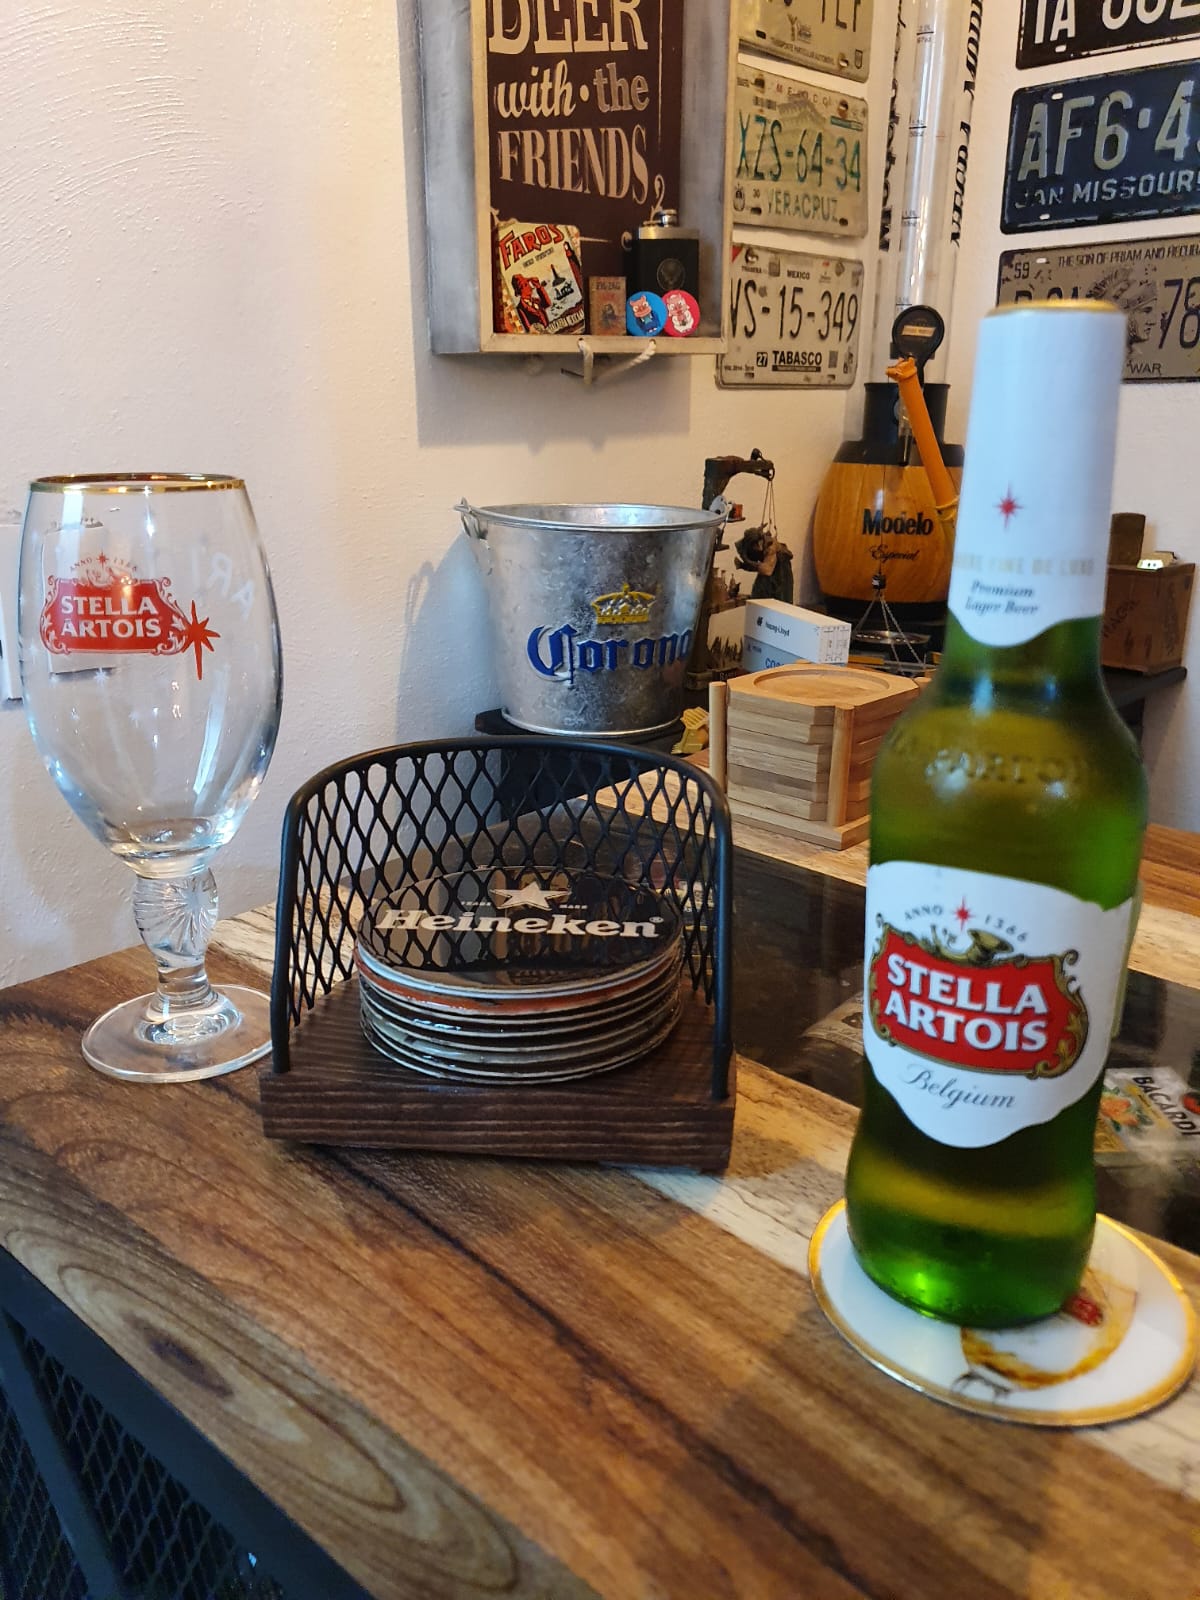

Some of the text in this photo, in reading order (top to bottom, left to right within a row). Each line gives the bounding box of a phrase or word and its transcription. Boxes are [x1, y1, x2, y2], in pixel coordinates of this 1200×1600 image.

[497, 59, 650, 118] with the
[497, 124, 649, 205] FRIENDS
[1072, 168, 1200, 203] MISSOUR
[499, 224, 564, 270] FAROS
[1059, 255, 1073, 267] THE
[1096, 252, 1108, 264] OF
[1145, 247, 1166, 260] AND
[1014, 262, 1030, 279] 59
[730, 278, 858, 342] VS-15-349
[757, 351, 822, 366] 27 TABASCO
[1130, 362, 1161, 375] WAR
[862, 508, 934, 536] Modelo
[971, 579, 1034, 597] Premium
[61, 595, 158, 615] STELLA
[965, 597, 1039, 616] Lager Beer
[61, 618, 161, 638] ARTOIS
[374, 909, 659, 938] Heineken
[904, 904, 1029, 943] ANNO 1366
[886, 952, 1049, 1015] STELLA
[884, 990, 1048, 1052] ARTOIS
[902, 1062, 1016, 1109] Belgium
